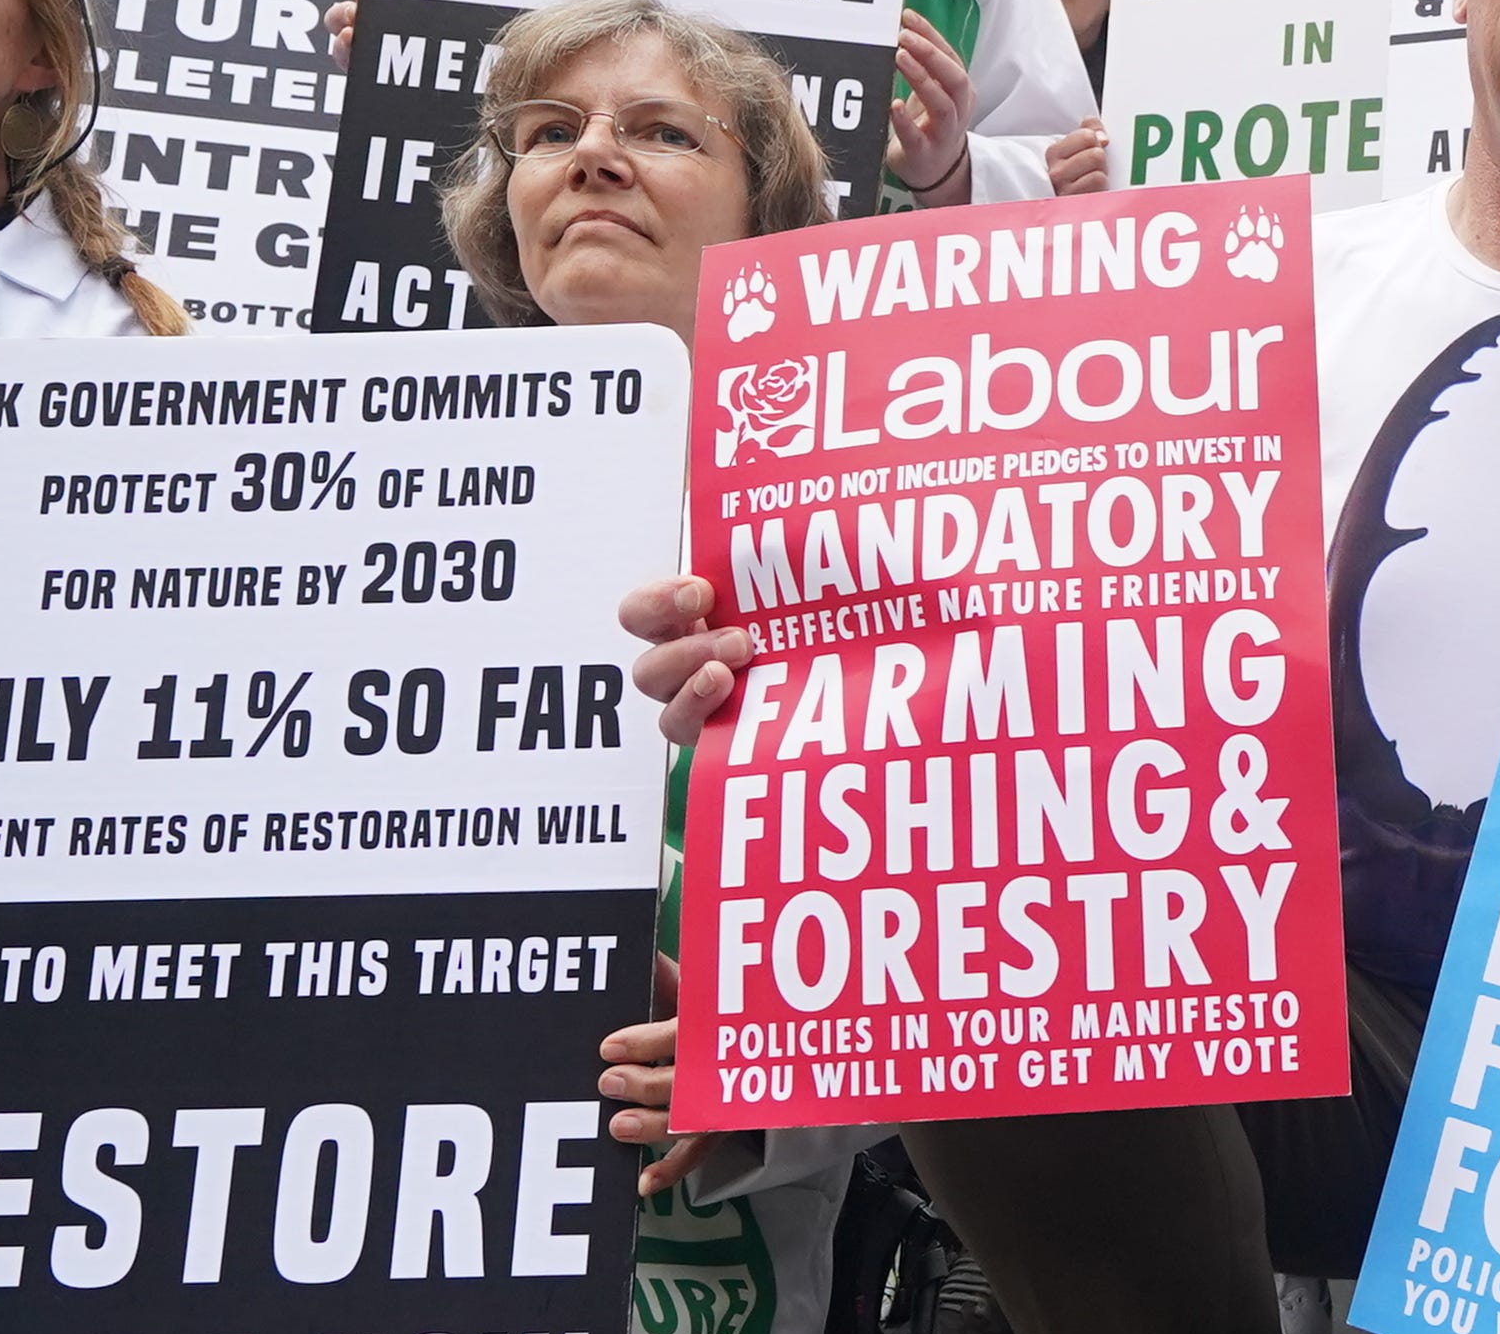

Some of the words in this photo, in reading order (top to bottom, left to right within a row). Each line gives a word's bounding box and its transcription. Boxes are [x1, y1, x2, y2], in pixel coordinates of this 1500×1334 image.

[1282, 21, 1334, 67] IN
[800, 210, 1201, 328] WARNING
[39, 377, 344, 427] GOVERNMENT
[361, 371, 577, 422] COMMITS
[592, 368, 641, 416] TO
[823, 324, 1283, 450] Labour
[729, 470, 1278, 614] MANDATORY
[139, 670, 312, 762] 11%
[344, 665, 455, 757] SO
[476, 663, 623, 753] FAR
[726, 609, 1286, 767] FARMING
[0, 945, 66, 1003] TO
[90, 941, 238, 1001] MEET
[265, 937, 388, 996] THIS
[417, 934, 618, 993] TARGET
[717, 862, 1298, 1015] FORESTRY
